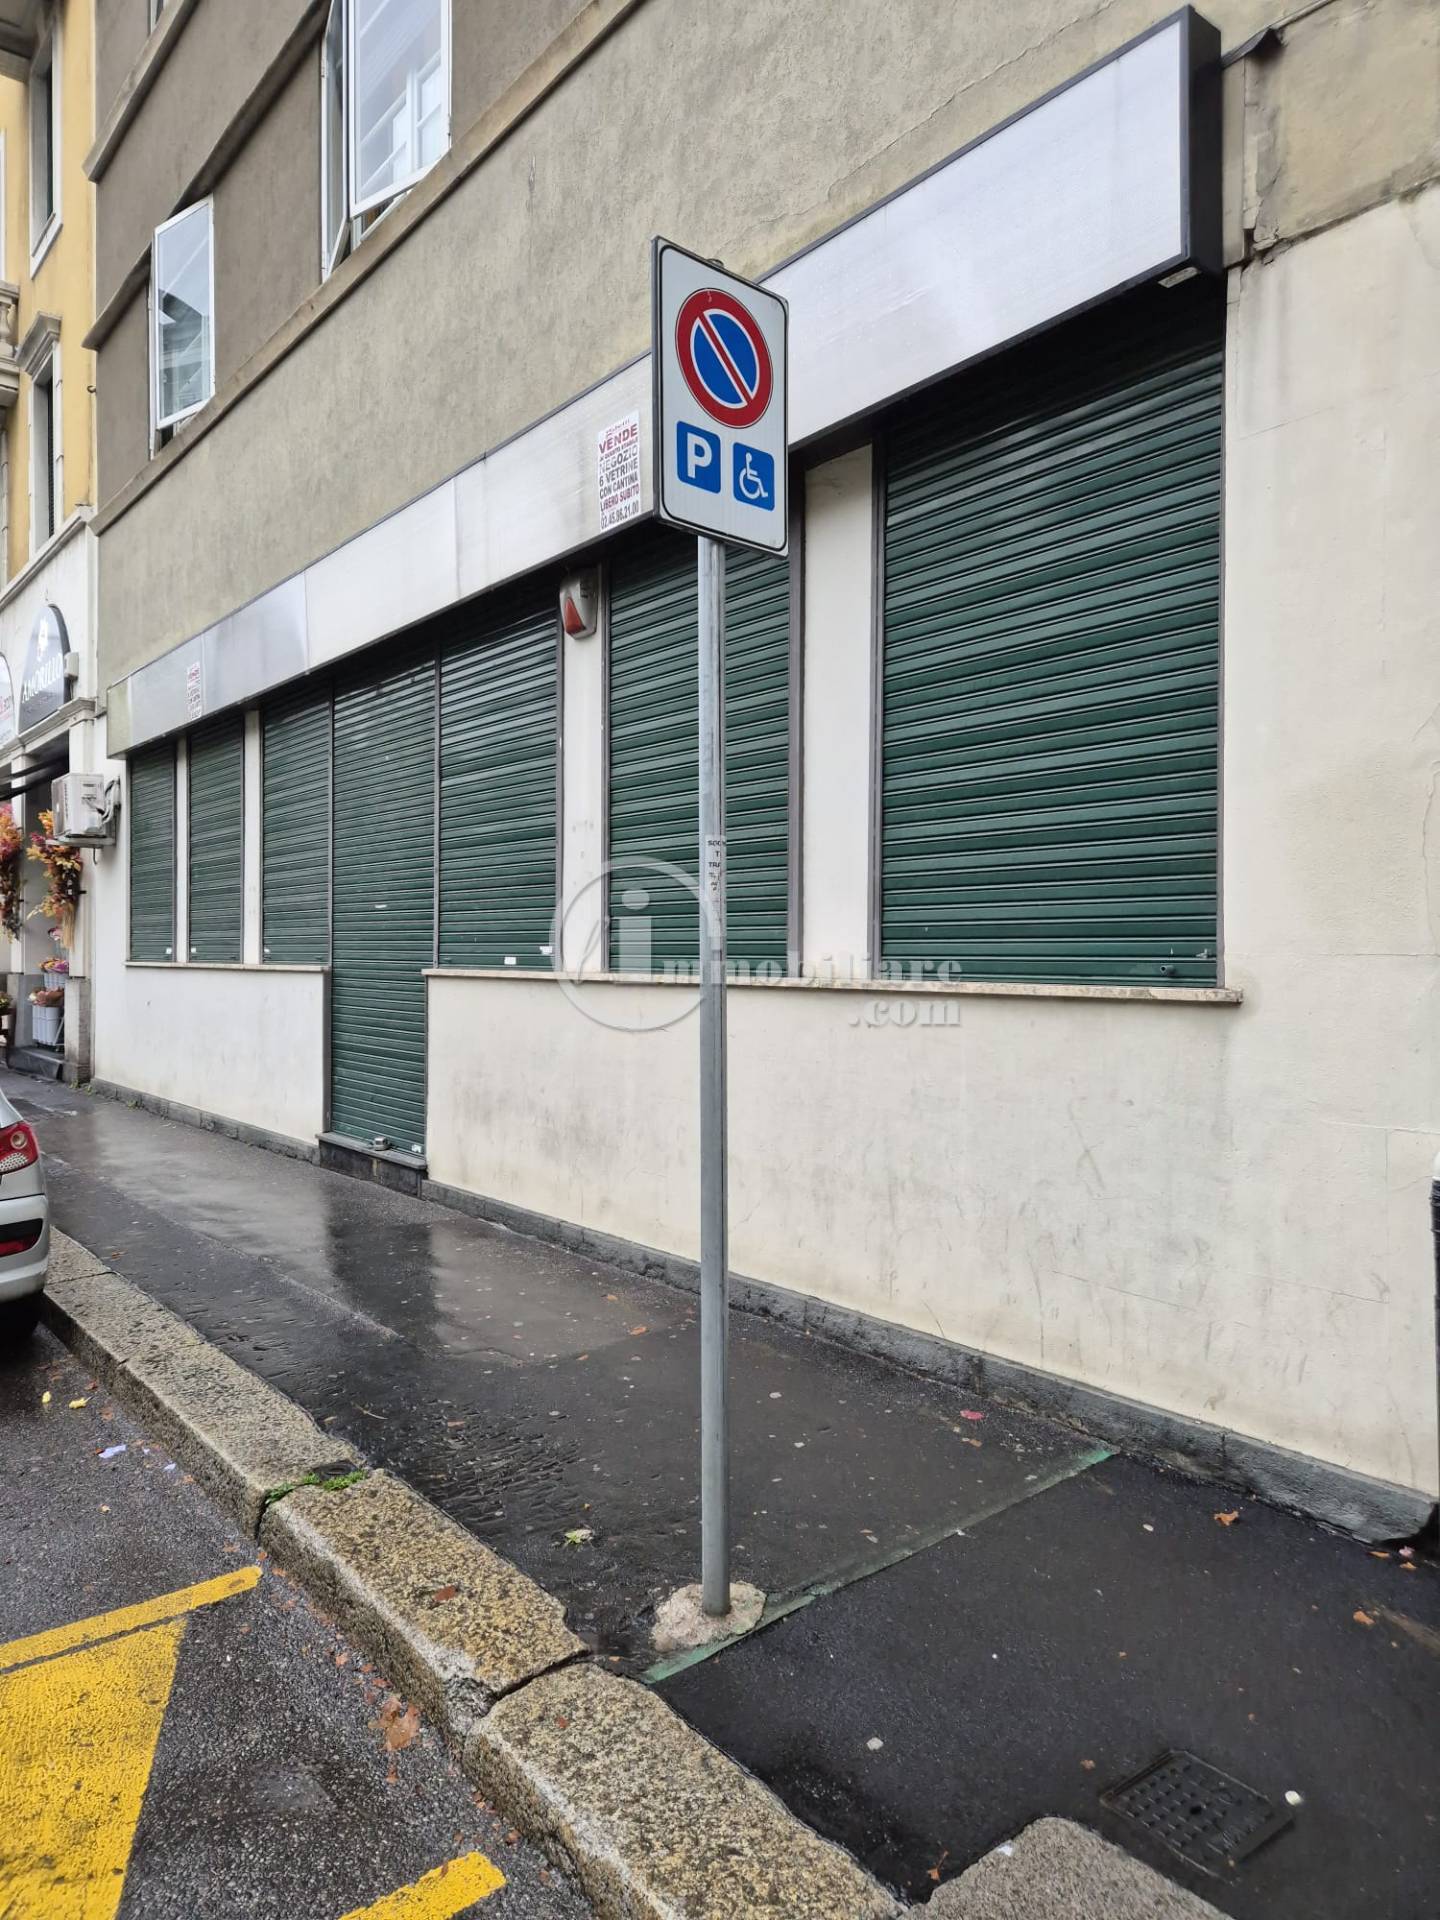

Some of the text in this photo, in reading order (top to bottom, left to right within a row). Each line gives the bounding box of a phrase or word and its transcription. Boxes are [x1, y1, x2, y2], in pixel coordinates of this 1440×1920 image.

[599, 423, 638, 454] VENDE
[599, 444, 638, 474] NEGOZIO
[686, 431, 713, 480] P
[599, 457, 638, 487] 6 VETRINE
[599, 471, 639, 500] CON CANTINA
[600, 482, 640, 512] LIBERO SUBITO
